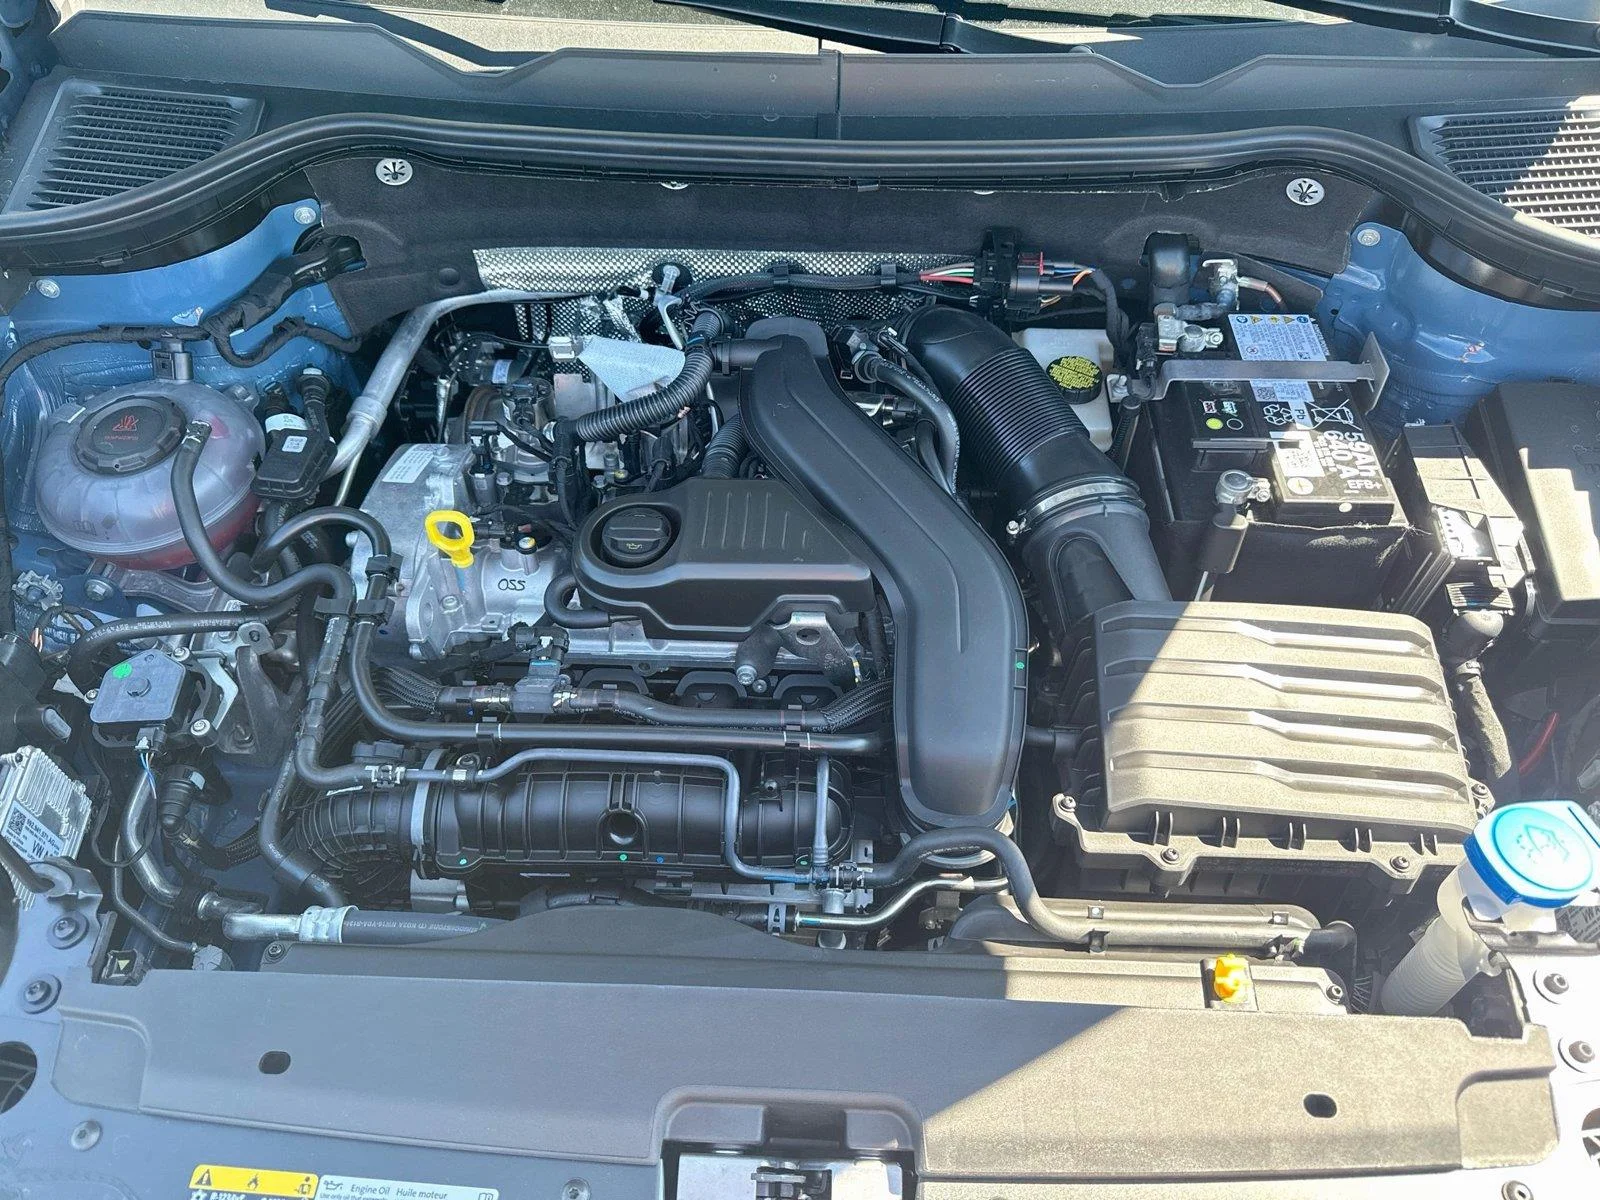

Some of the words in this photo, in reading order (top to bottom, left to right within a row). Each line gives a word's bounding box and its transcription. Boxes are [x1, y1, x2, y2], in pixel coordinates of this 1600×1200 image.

[1295, 409, 1306, 419] Pb
[1323, 430, 1353, 461] 640
[1345, 432, 1379, 477] 59Ah
[1336, 464, 1360, 479] A
[351, 1184, 377, 1195] Engine
[379, 1186, 390, 1195] Oil
[396, 1188, 416, 1197] Huile
[419, 1191, 447, 1199] moteur
